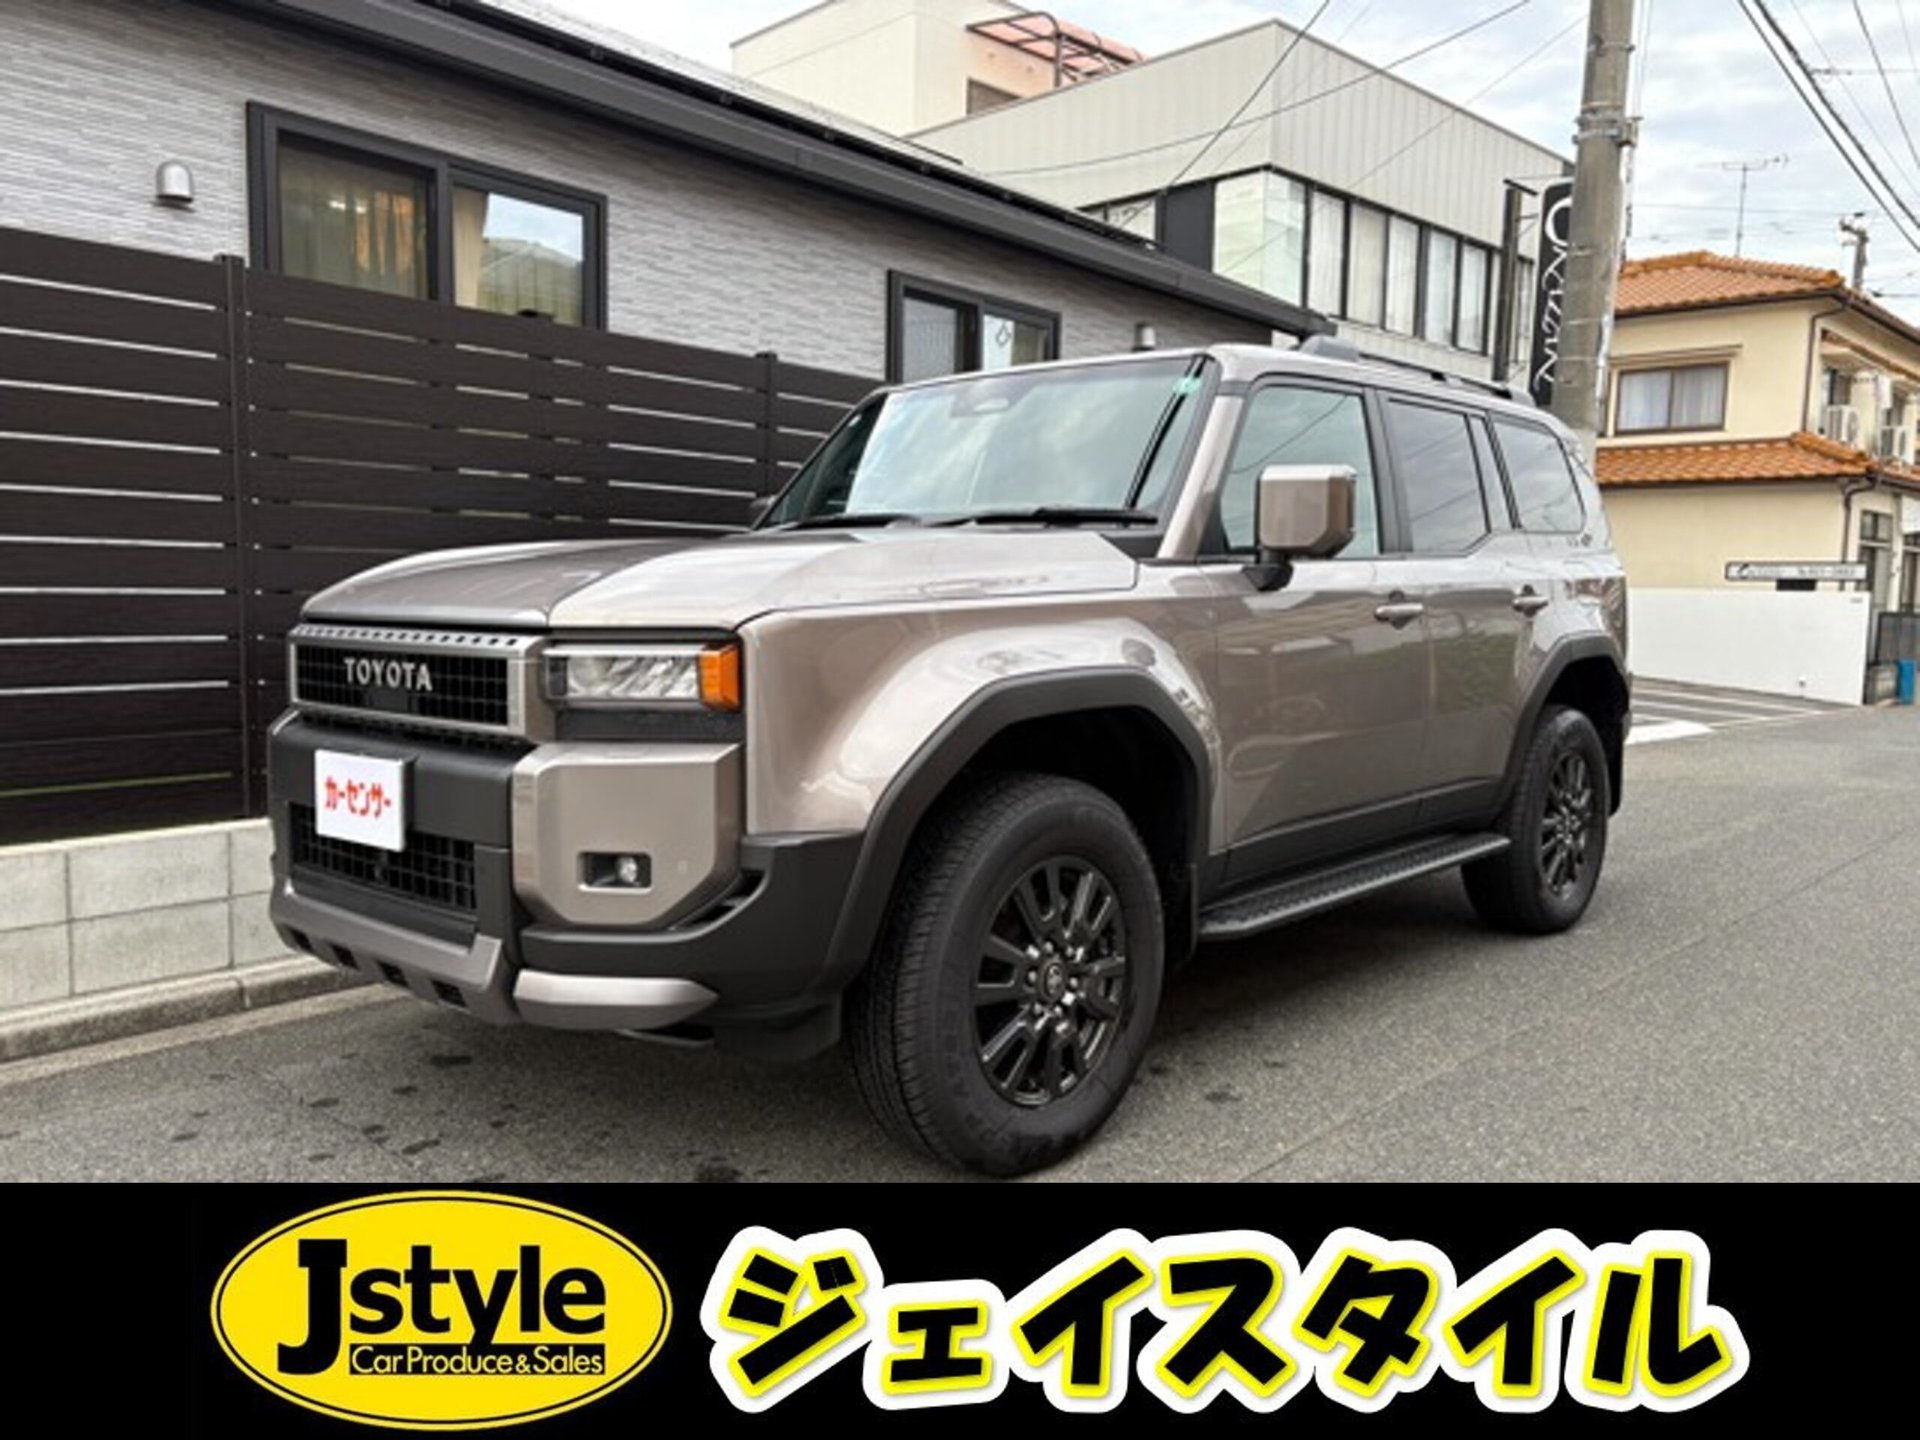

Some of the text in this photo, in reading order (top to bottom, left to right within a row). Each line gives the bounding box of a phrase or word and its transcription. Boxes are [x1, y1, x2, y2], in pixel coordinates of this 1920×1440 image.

[344, 656, 433, 692] TOYOTA
[325, 776, 393, 819] カーセンサー
